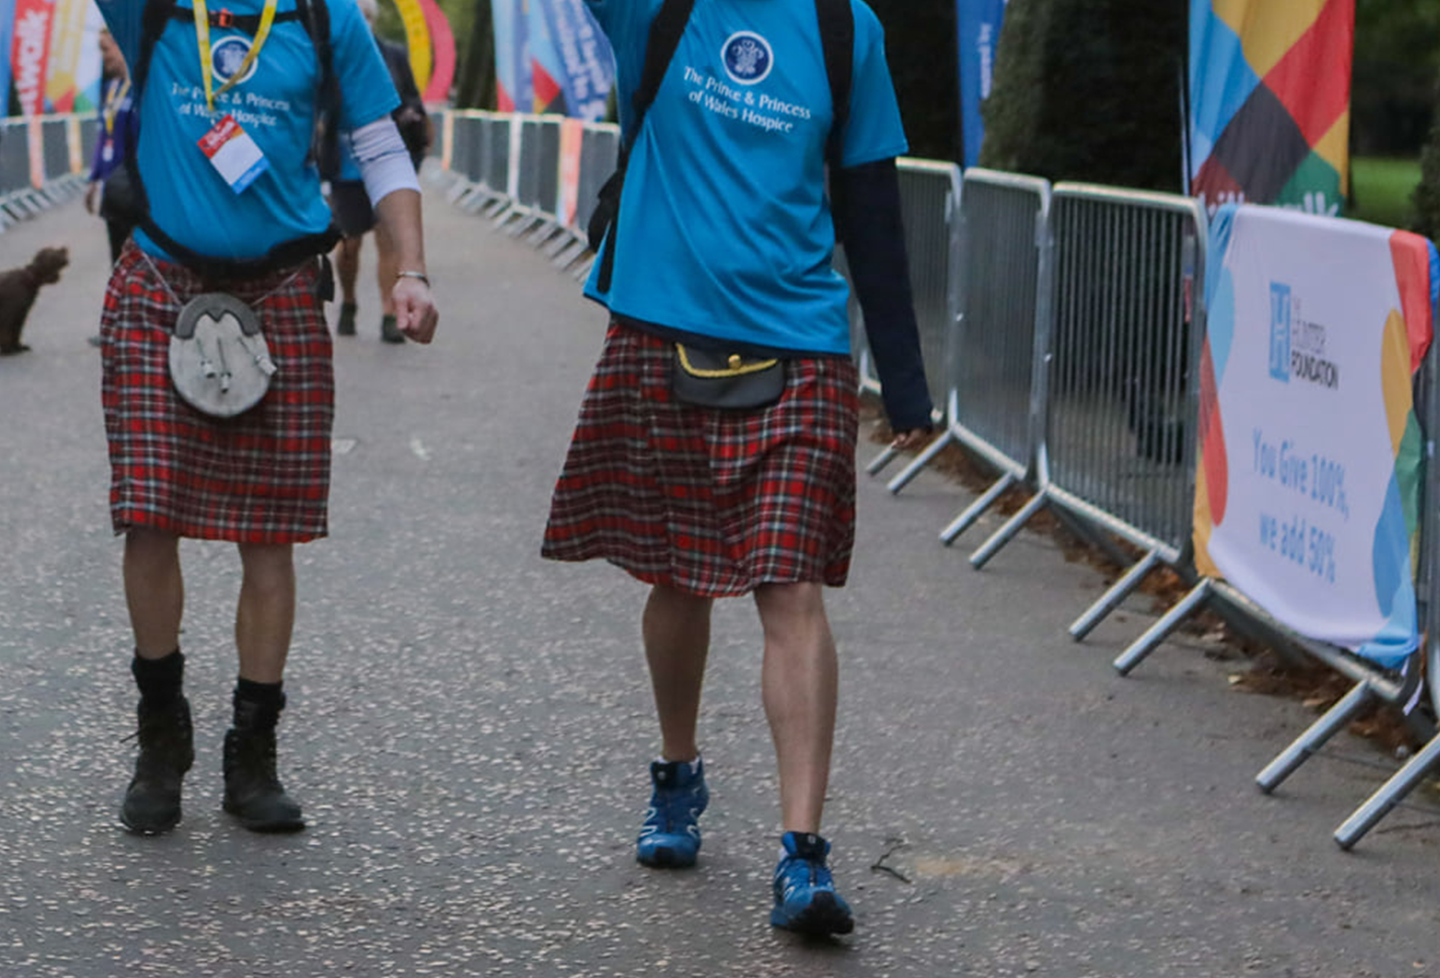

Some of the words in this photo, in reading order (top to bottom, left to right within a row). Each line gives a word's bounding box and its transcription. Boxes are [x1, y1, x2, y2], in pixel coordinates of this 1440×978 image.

[232, 92, 242, 105] &
[683, 66, 703, 85] The
[705, 76, 742, 102] Prince
[744, 91, 755, 106] &
[759, 94, 811, 120] Princess
[688, 90, 704, 104] of
[705, 94, 738, 120] Wales
[742, 108, 794, 133] Hospice
[1252, 427, 1277, 479] You
[1280, 438, 1308, 494] Give
[1259, 512, 1277, 551] we
[1281, 514, 1306, 566] add
[1309, 525, 1337, 584] 50%
